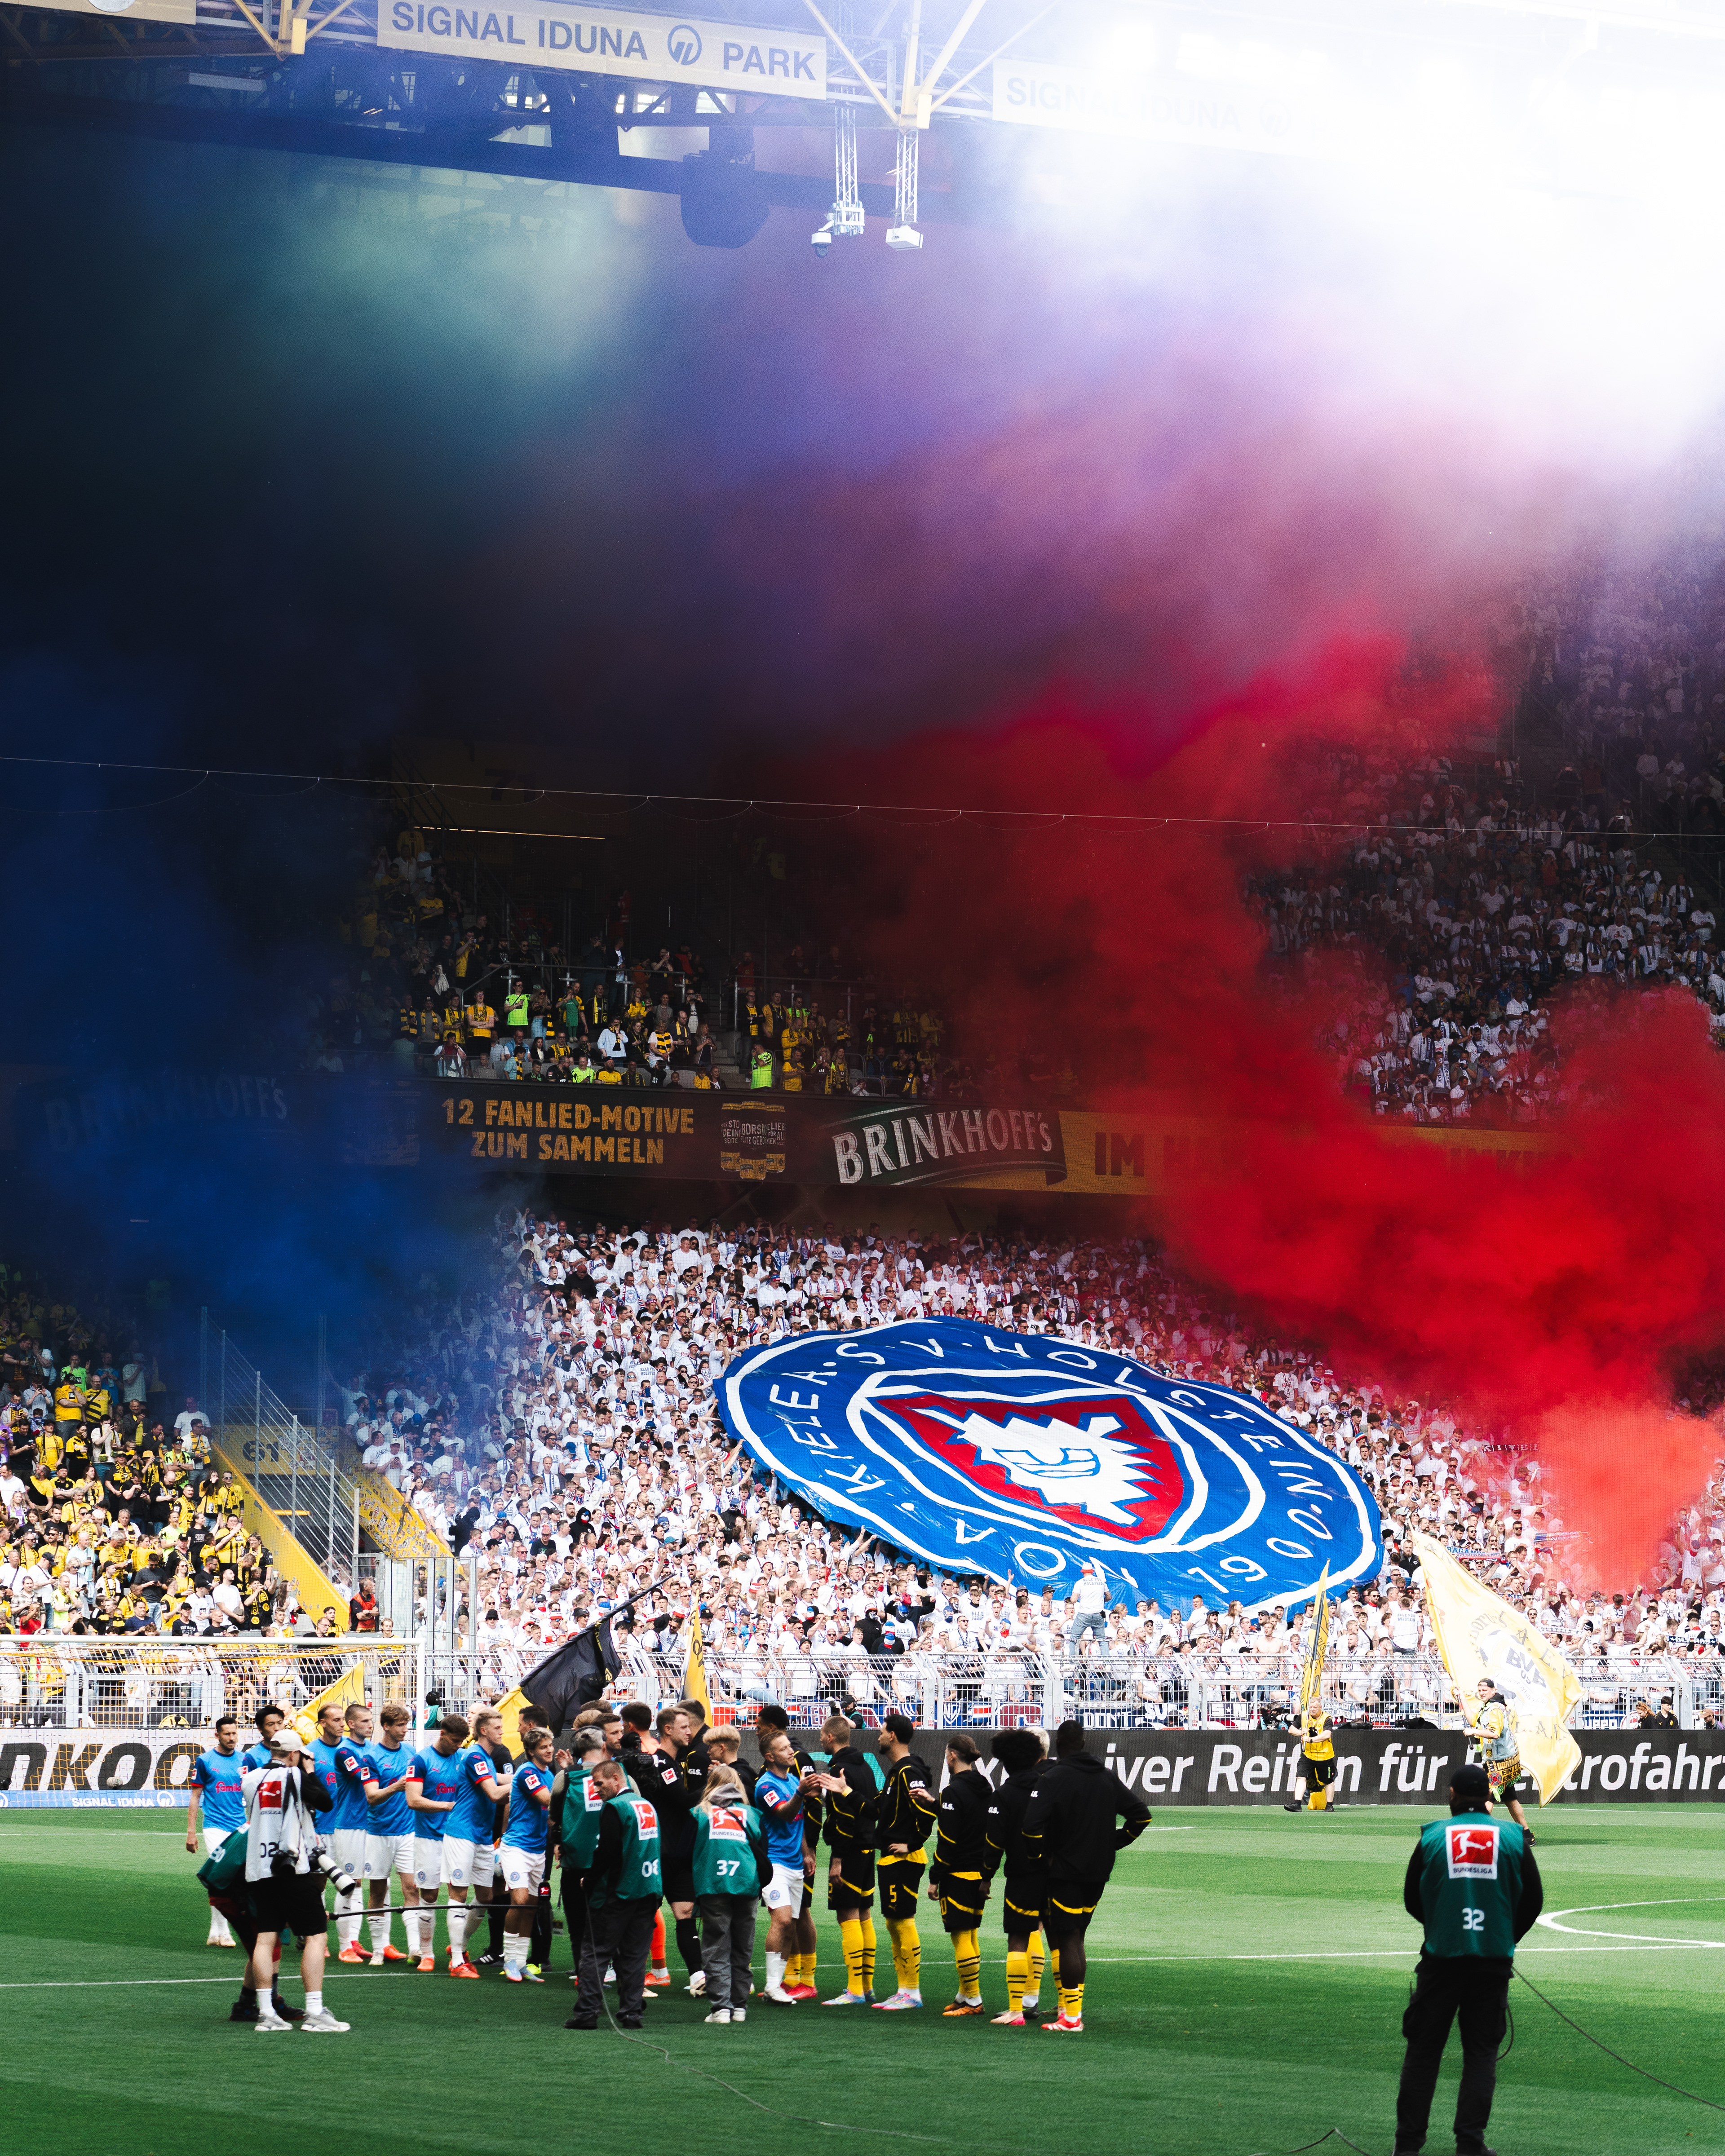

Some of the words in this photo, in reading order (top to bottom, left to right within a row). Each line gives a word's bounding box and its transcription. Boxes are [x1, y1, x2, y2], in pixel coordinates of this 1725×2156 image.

[392, 1, 525, 45] SIGNAL
[539, 20, 648, 60] IDUNA
[723, 41, 817, 80] PARK
[1007, 76, 1131, 119] SIGNAL
[1140, 93, 1243, 132] IDUNA
[442, 1098, 474, 1124] 12
[486, 1100, 694, 1134] FANLIED-MOTIVE
[471, 1131, 527, 1158] ZUM
[540, 1135, 663, 1164] SAMMELN
[1095, 1132, 1145, 1177] IM
[1379, 1743, 1449, 1792] für
[72, 1798, 116, 1807] SIGNAL
[118, 1798, 155, 1807] IDUNA
[717, 1860, 740, 1876] 37
[889, 1885, 898, 1903] 5
[1462, 1908, 1485, 1931] 32
